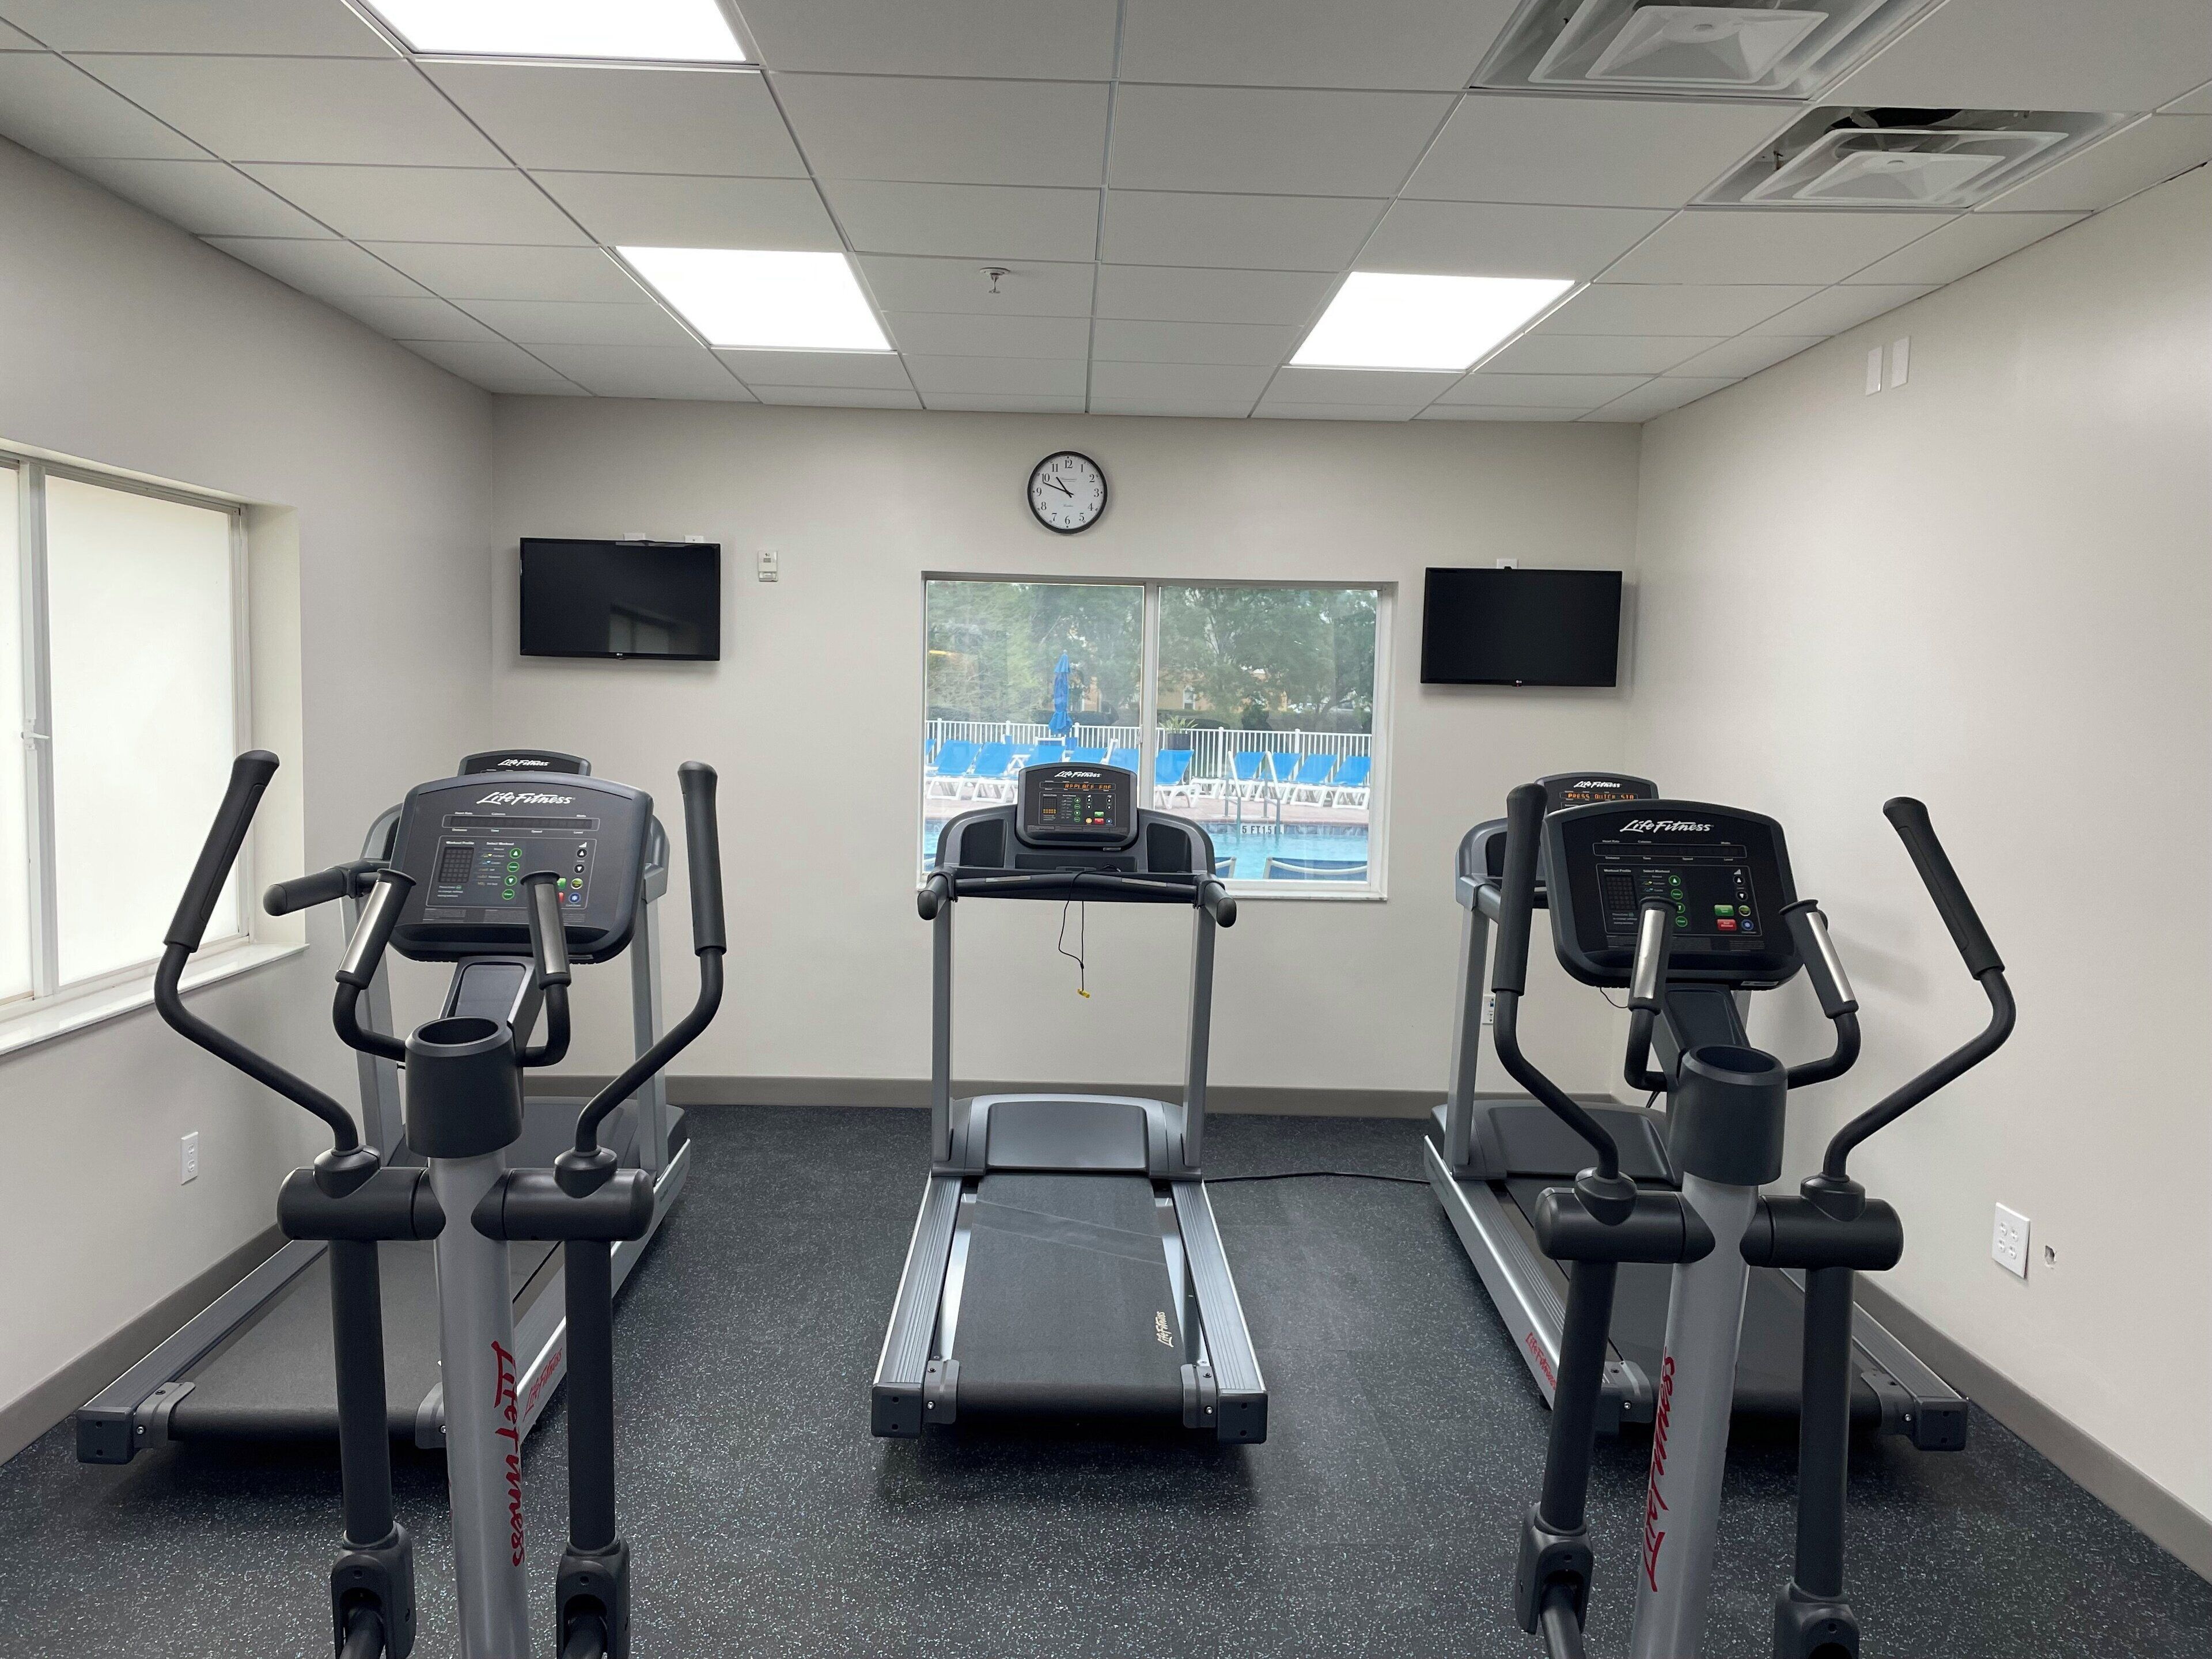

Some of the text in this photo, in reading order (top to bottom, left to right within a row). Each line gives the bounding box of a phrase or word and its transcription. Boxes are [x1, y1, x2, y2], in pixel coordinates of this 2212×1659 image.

[1051, 463, 1058, 472] 11
[1065, 459, 1073, 469] 12
[1081, 464, 1084, 473] 1
[1041, 473, 1050, 482] 10
[1089, 474, 1095, 483] 2
[1036, 487, 1042, 497] 9
[1093, 488, 1100, 498] 3
[1040, 501, 1047, 510] 8
[1088, 502, 1094, 512] 4
[1051, 513, 1057, 521] 7
[1065, 516, 1070, 525] 6
[1079, 513, 1085, 521] 5
[1242, 825, 1247, 834] 5
